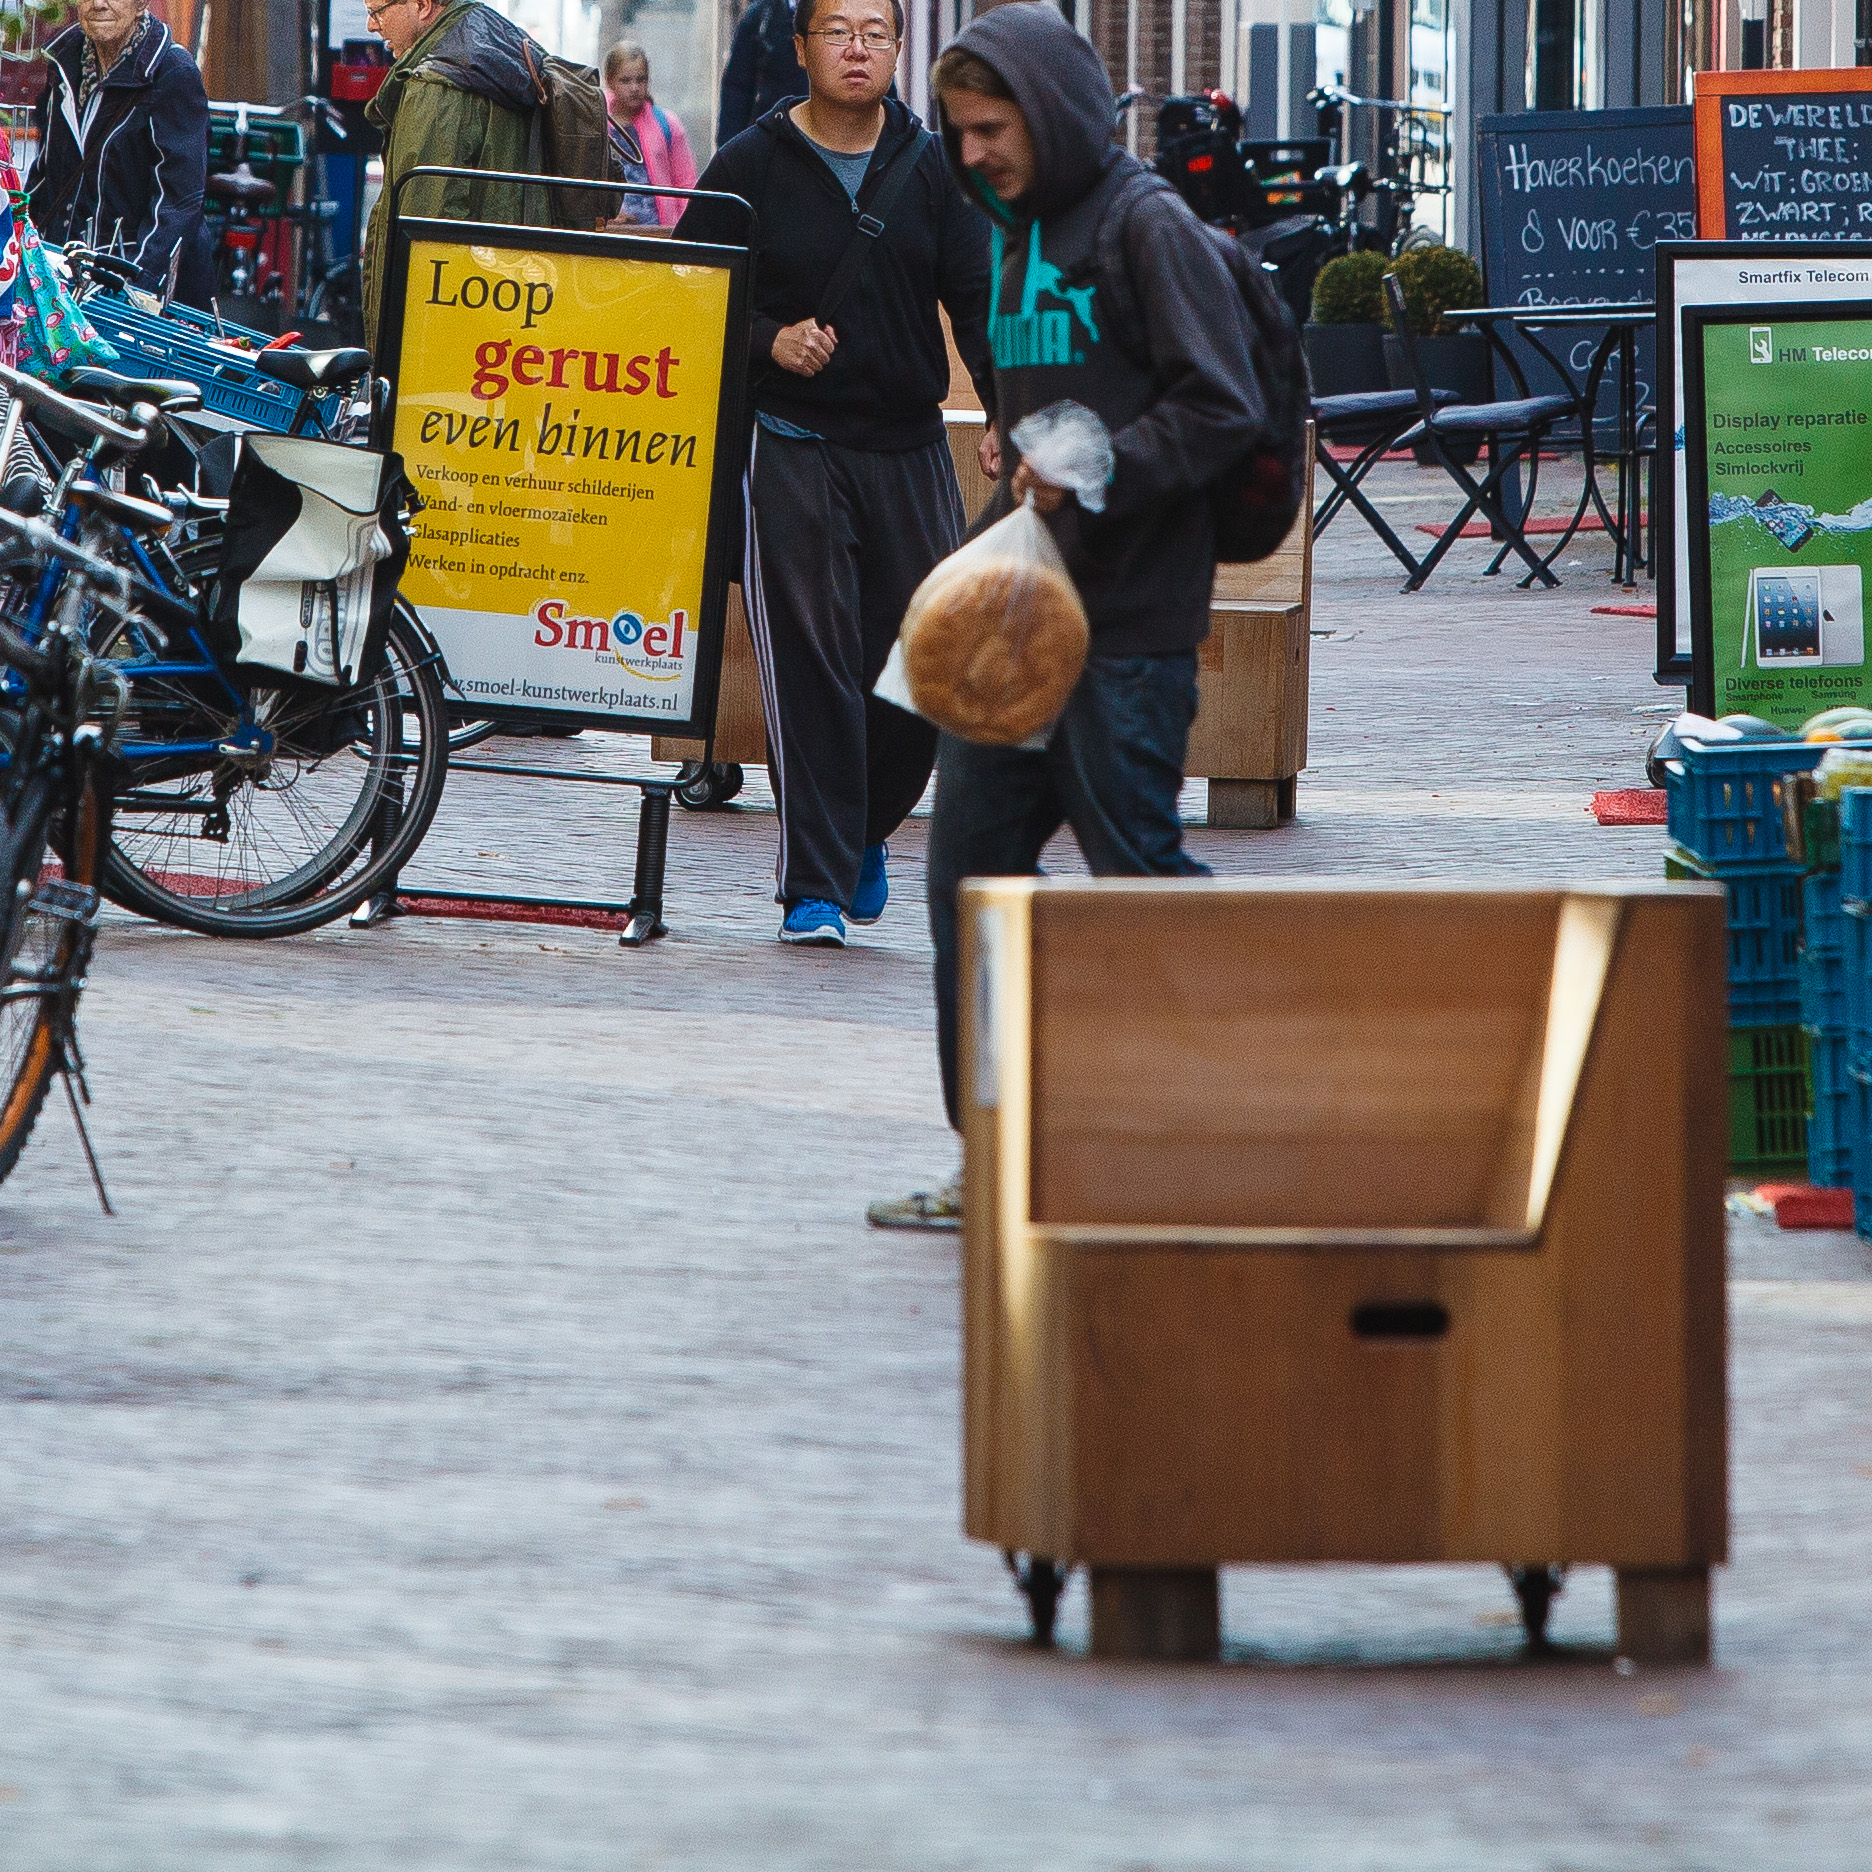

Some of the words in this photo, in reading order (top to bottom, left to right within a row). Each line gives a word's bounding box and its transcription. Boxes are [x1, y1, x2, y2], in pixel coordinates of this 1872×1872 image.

[1728, 103, 1763, 129] DE
[1773, 135, 1859, 164] THEE:
[1738, 269, 1802, 285] Smartfix
[1805, 268, 1870, 284] Telecom
[425, 258, 554, 330] Loop
[1778, 347, 1807, 363] HM
[470, 337, 681, 401] gerust
[1712, 412, 1781, 431] Display
[1786, 409, 1869, 430] reparatie
[419, 409, 521, 452] even
[536, 401, 697, 468] binnen
[1713, 439, 1813, 455] Accessoires
[1714, 459, 1805, 477] Simlockvrij
[415, 463, 480, 488] Verkoop
[481, 474, 501, 486] en
[503, 473, 565, 492] verhuur
[566, 477, 655, 503] schilderijen
[416, 494, 464, 513] Wand-
[466, 502, 486, 515] en
[488, 499, 609, 526] vloermozaïeken
[412, 523, 521, 548] Glasapplicaties
[407, 552, 467, 573] Werken
[470, 557, 486, 575] in
[488, 560, 557, 582] opdracht
[558, 568, 591, 585] enz.
[534, 601, 685, 660] Smoel
[593, 650, 684, 673] kunstwerkplaats
[1725, 677, 1785, 691] Diverse
[1789, 674, 1864, 690] telefoons
[1811, 689, 1858, 701] Samsung
